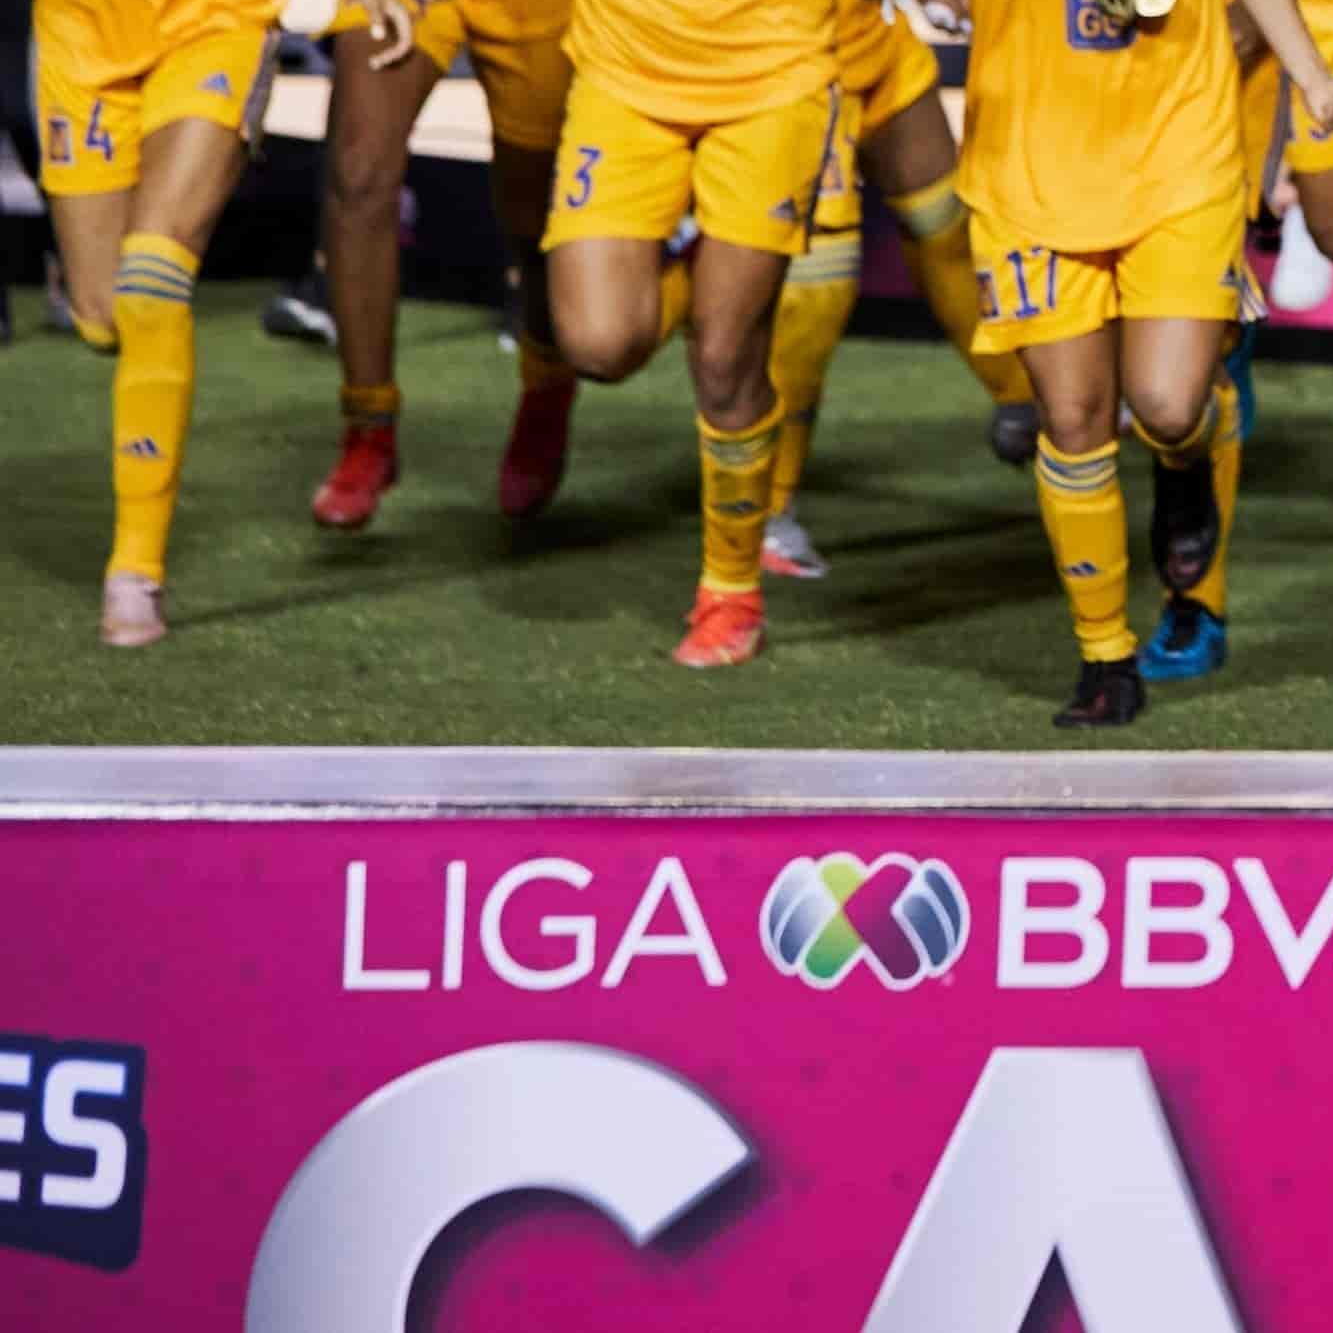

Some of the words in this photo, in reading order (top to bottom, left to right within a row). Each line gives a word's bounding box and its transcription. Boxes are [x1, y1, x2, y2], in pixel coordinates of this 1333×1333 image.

[84, 100, 114, 162] 4
[566, 146, 602, 208] 3
[1006, 245, 1060, 321] 17
[343, 856, 727, 991] LIGA
